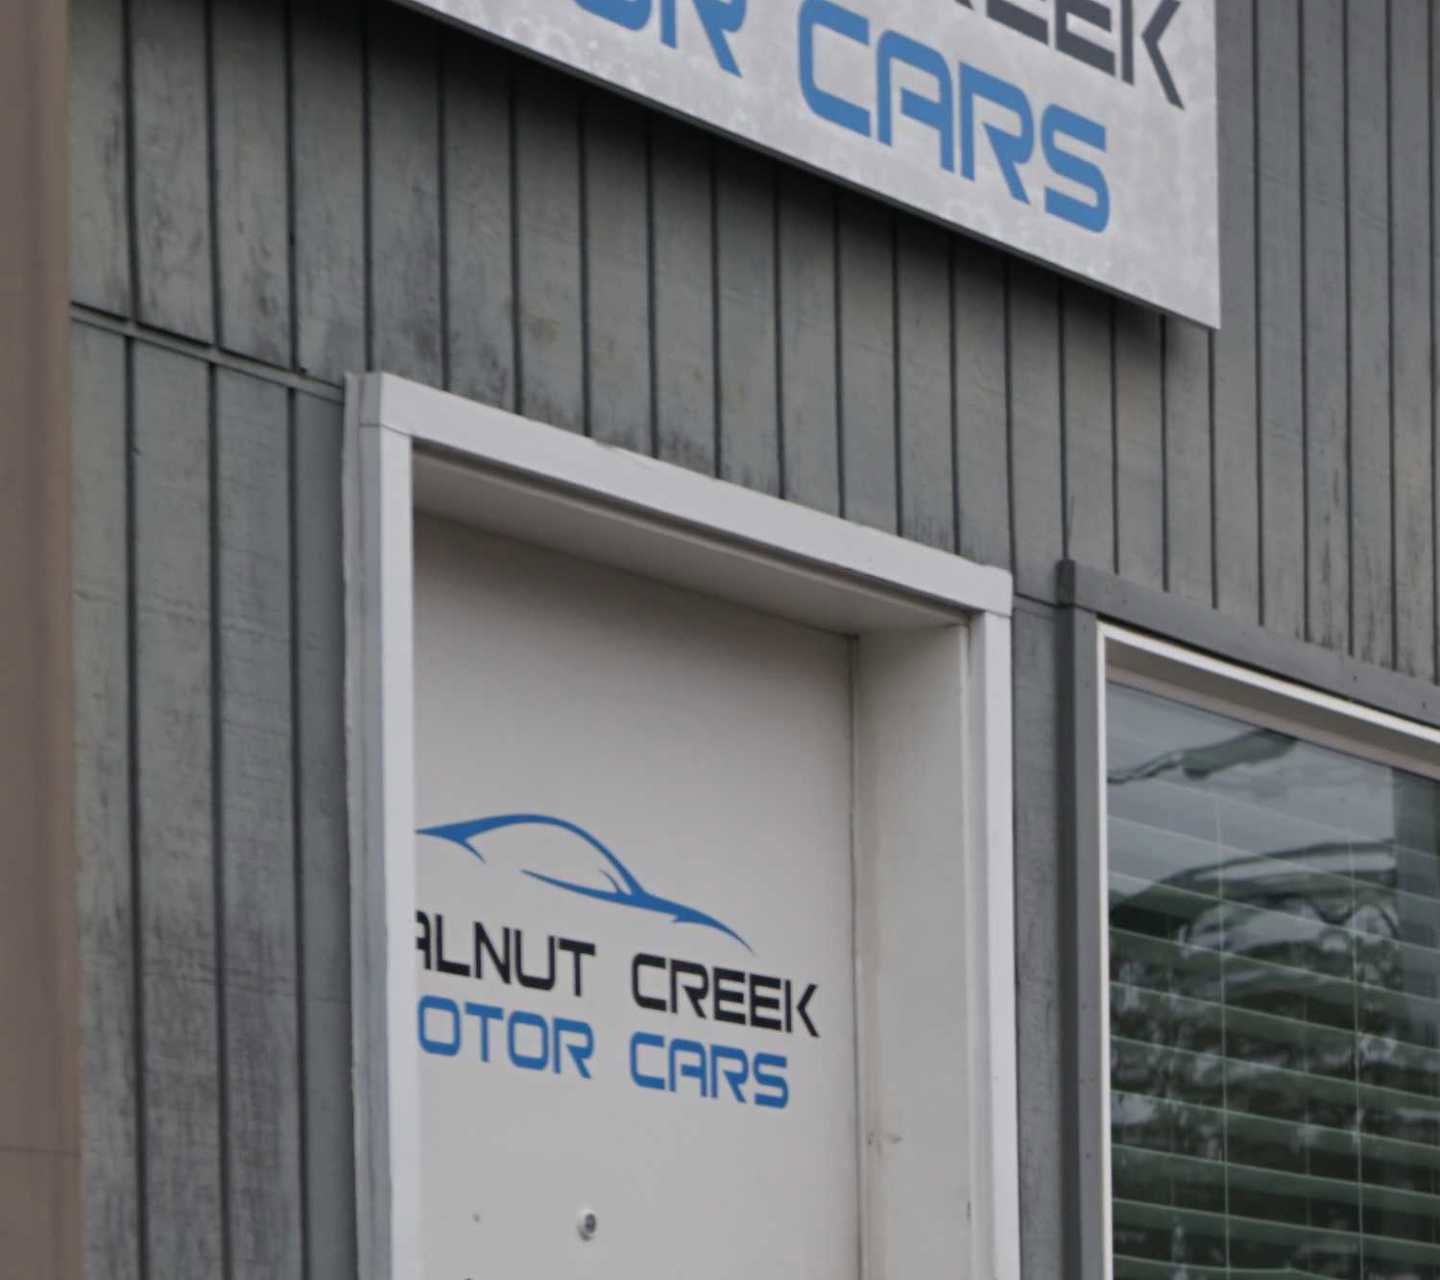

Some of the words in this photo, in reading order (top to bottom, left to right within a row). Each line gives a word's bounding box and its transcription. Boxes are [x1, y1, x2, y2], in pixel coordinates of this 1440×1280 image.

[798, 0, 1110, 234] CARS
[630, 952, 820, 1038] CREEK
[629, 1031, 789, 1109] CARS
